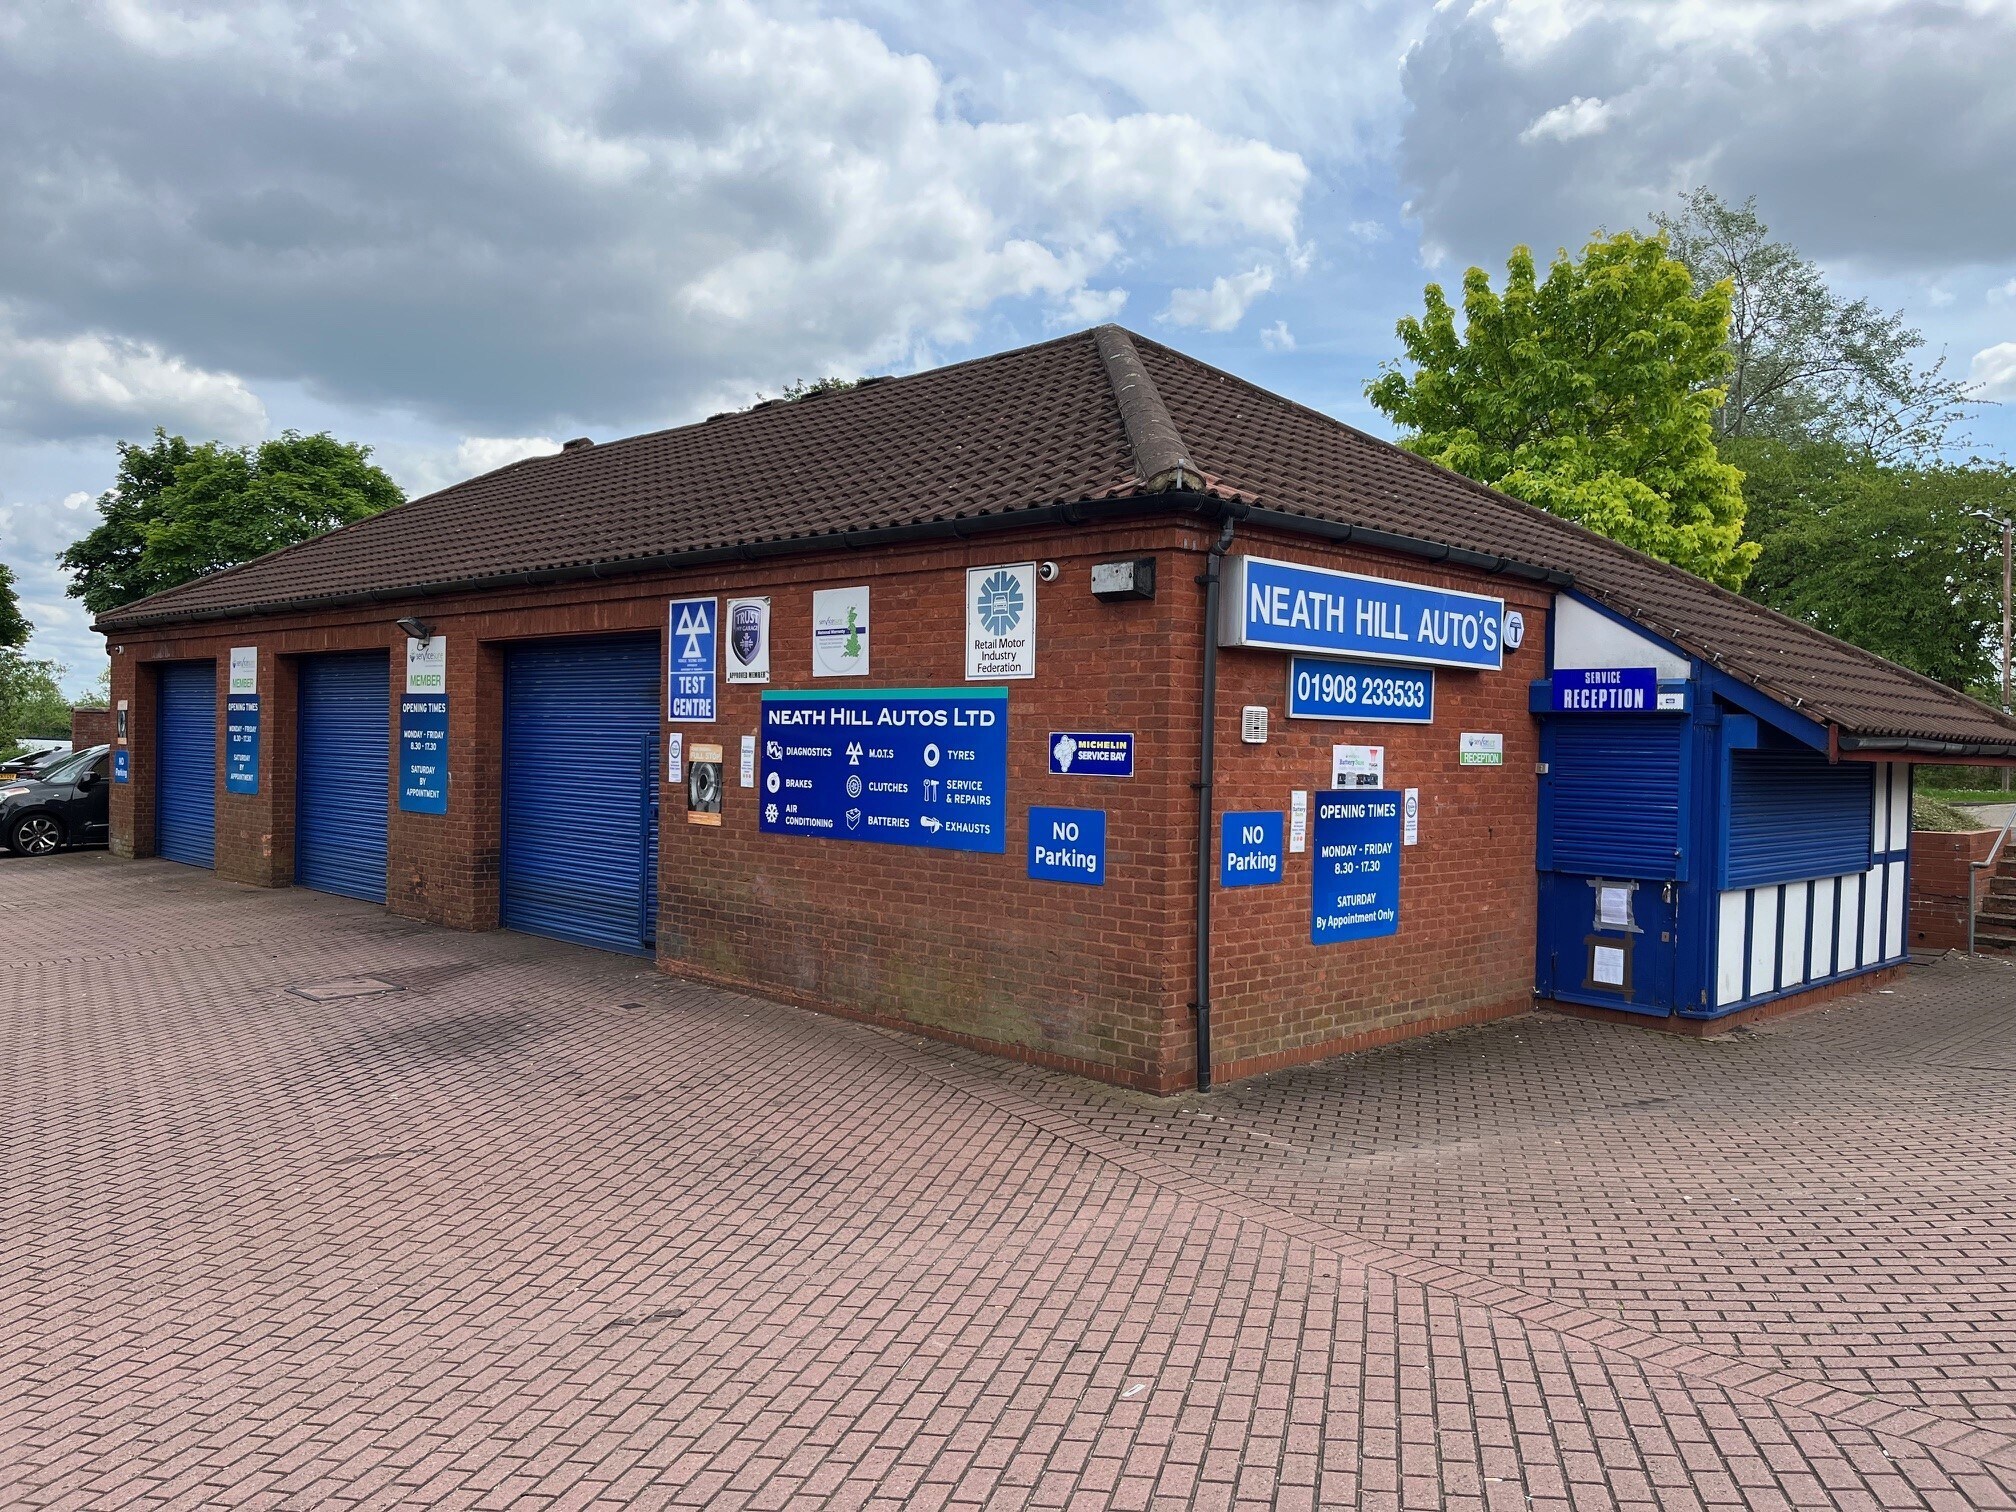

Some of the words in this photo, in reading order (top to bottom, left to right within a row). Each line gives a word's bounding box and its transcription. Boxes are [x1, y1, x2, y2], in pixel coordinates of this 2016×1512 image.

[736, 610, 759, 624] TRUST
[1250, 582, 1345, 634] NEATH
[1356, 598, 1409, 642] HILL
[1417, 608, 1497, 651] AUTO'S
[975, 639, 997, 650] Retail
[999, 638, 1025, 649] Motor
[981, 650, 1017, 662] Industry
[977, 662, 1022, 673] Federation
[410, 674, 441, 687] MEMBER
[748, 671, 766, 679] MEMBER
[1584, 671, 1621, 684] SERVICE
[232, 678, 254, 688] MEMBER
[679, 675, 706, 695] TEST
[1297, 671, 1357, 703] 01908
[1361, 677, 1424, 708] 233533
[1563, 688, 1644, 709] RECEPTION
[228, 703, 245, 711] OPENING
[246, 703, 258, 712] TIMES
[402, 702, 427, 713] OPENING
[428, 702, 446, 713] TIMES
[673, 697, 712, 717] CENTRE
[768, 710, 825, 726] NEATH
[830, 707, 873, 726] HILL
[877, 707, 948, 727] AUTOS
[953, 707, 995, 727] LTD
[404, 730, 423, 739] MONDAY
[427, 731, 444, 740] FRIDAY
[410, 742, 421, 750] 8.30
[1078, 740, 1127, 750] MICHELIN
[786, 746, 832, 757] DIAGNOSTICS
[947, 750, 976, 761] TYRES
[1078, 750, 1110, 761] SERVICE
[1110, 752, 1126, 762] BAY
[1464, 752, 1498, 763] RECEPTION
[118, 757, 125, 766] NO
[234, 754, 250, 762] SATURDAY
[410, 764, 436, 775] SATURDAY
[419, 777, 426, 786] BY
[785, 779, 812, 789] BRAKES
[868, 782, 908, 793] CLUTCHES
[946, 780, 983, 791] SERVICE
[406, 788, 440, 799] APPOINTMENT
[946, 794, 952, 804] &
[954, 794, 991, 806] REPAIRS
[786, 804, 798, 814] AIR
[1320, 804, 1366, 819] OPENING
[1368, 804, 1396, 818] TIMES
[785, 816, 834, 828] CONDITIONING
[868, 816, 910, 828] BATTERIES
[945, 822, 991, 835] EXHAUSTS
[1052, 822, 1079, 842] NO
[1242, 826, 1264, 845] NO
[1322, 845, 1358, 858] MONDAY
[1364, 842, 1392, 856] FRIDAY
[1035, 846, 1097, 873] Parking
[1227, 852, 1277, 872] Parking
[1334, 862, 1354, 875] 8.30
[1360, 860, 1380, 874] 17.30
[1337, 892, 1376, 908] SATURDAY
[1316, 916, 1326, 931] By
[1327, 912, 1377, 929] Appointment
[1378, 910, 1394, 922] Only
